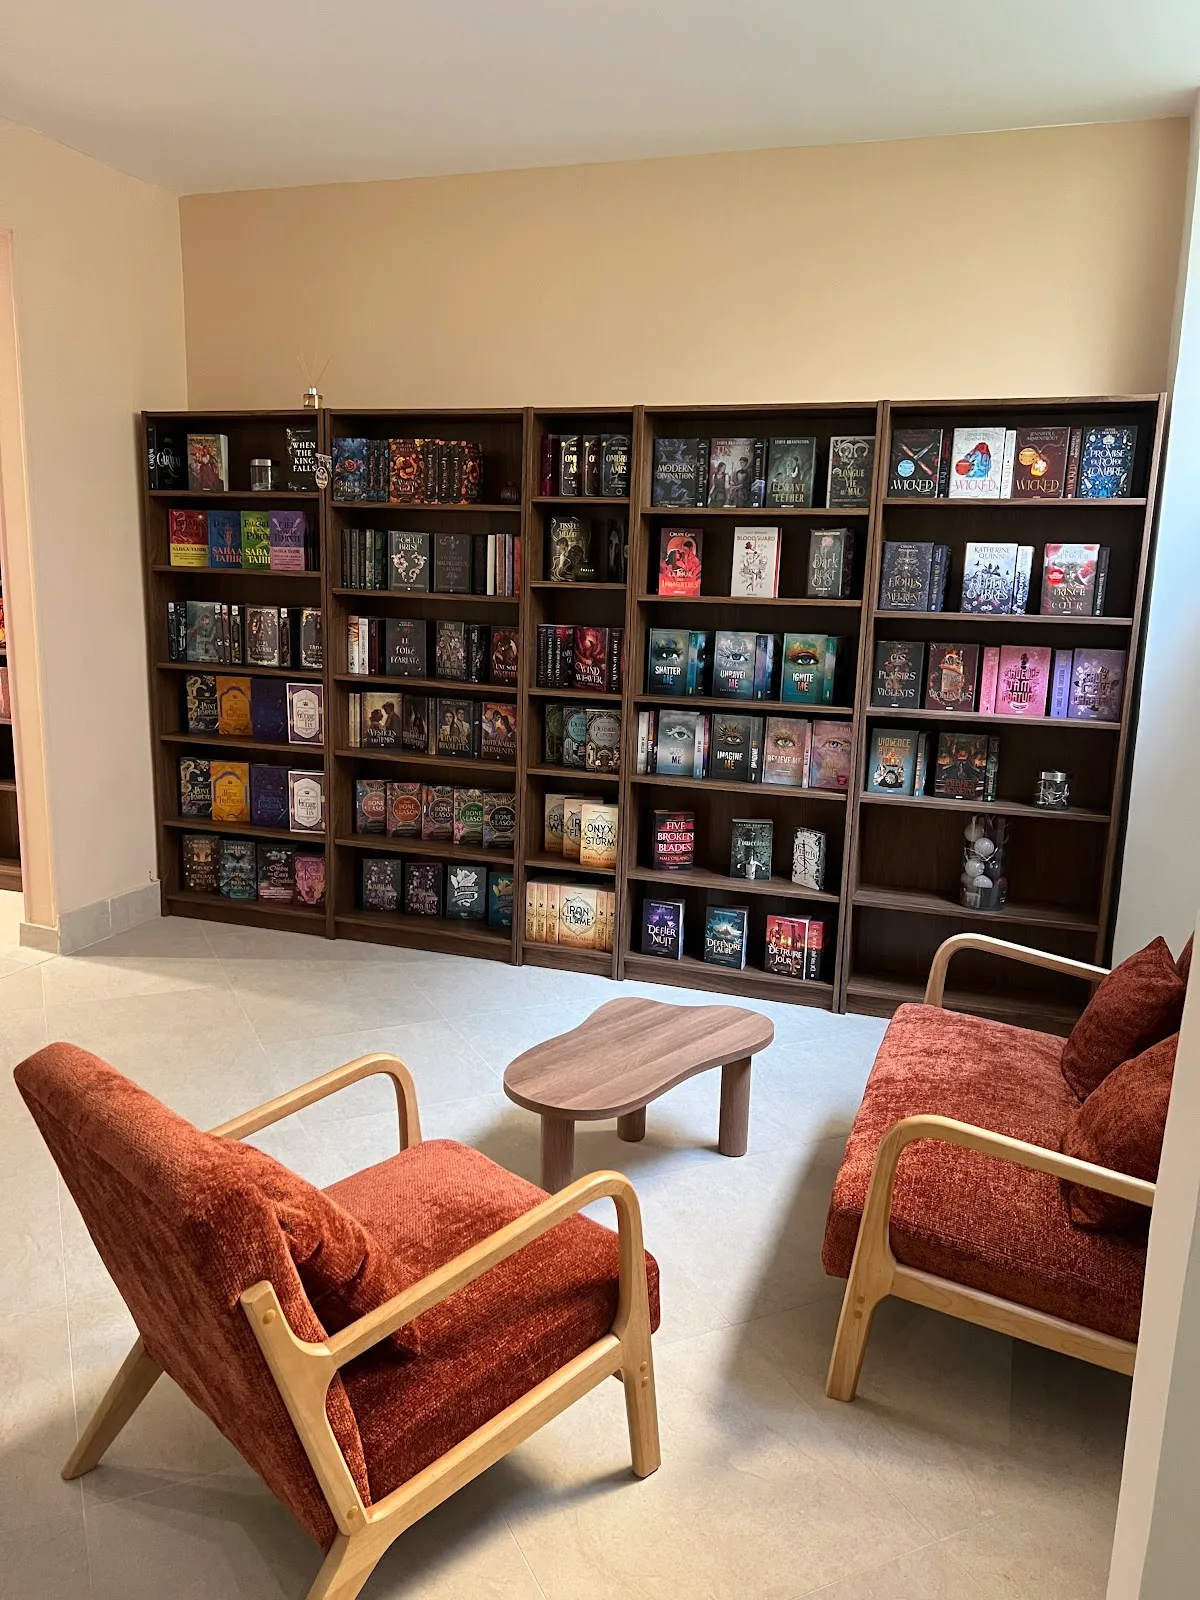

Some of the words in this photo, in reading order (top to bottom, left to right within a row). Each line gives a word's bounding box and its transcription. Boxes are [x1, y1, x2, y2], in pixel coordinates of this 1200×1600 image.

[292, 441, 316, 449] WHEN
[296, 449, 312, 457] THE
[294, 457, 314, 465] KING
[293, 465, 317, 473] FALLS
[657, 464, 694, 473] MODERN
[891, 479, 934, 493] WICKED
[953, 480, 996, 492] WICKED
[1016, 478, 1059, 492] WICKED
[212, 547, 242, 555] SABAA
[245, 547, 270, 556] SABA
[214, 555, 242, 564] TAHIR
[247, 555, 270, 564] TAHI
[890, 653, 907, 662] CES
[575, 662, 600, 676] WIND
[654, 665, 681, 675] SHATTER
[575, 673, 603, 684] WEAVER
[663, 674, 674, 684] ME
[720, 670, 746, 679] UNRAVEL
[792, 672, 814, 682] IGNITE
[878, 670, 917, 681] PLAISIRS
[728, 679, 739, 688] ME
[797, 681, 809, 691] ME
[877, 687, 915, 698] VIOLENTS
[671, 755, 682, 764] ME
[717, 751, 744, 761] IMAGINE
[767, 754, 791, 764] BELIEVE
[723, 759, 735, 770] ME
[587, 823, 614, 834] ONYX
[666, 822, 686, 830] FIVE
[585, 836, 615, 846] STORM
[657, 832, 694, 842] BROKEN
[737, 837, 770, 847] Powerless
[658, 843, 692, 852] BLADES
[566, 906, 589, 915] IRON
[565, 915, 591, 926] FLAME
[651, 932, 674, 946] NUIT
[773, 955, 792, 966] JOUR
